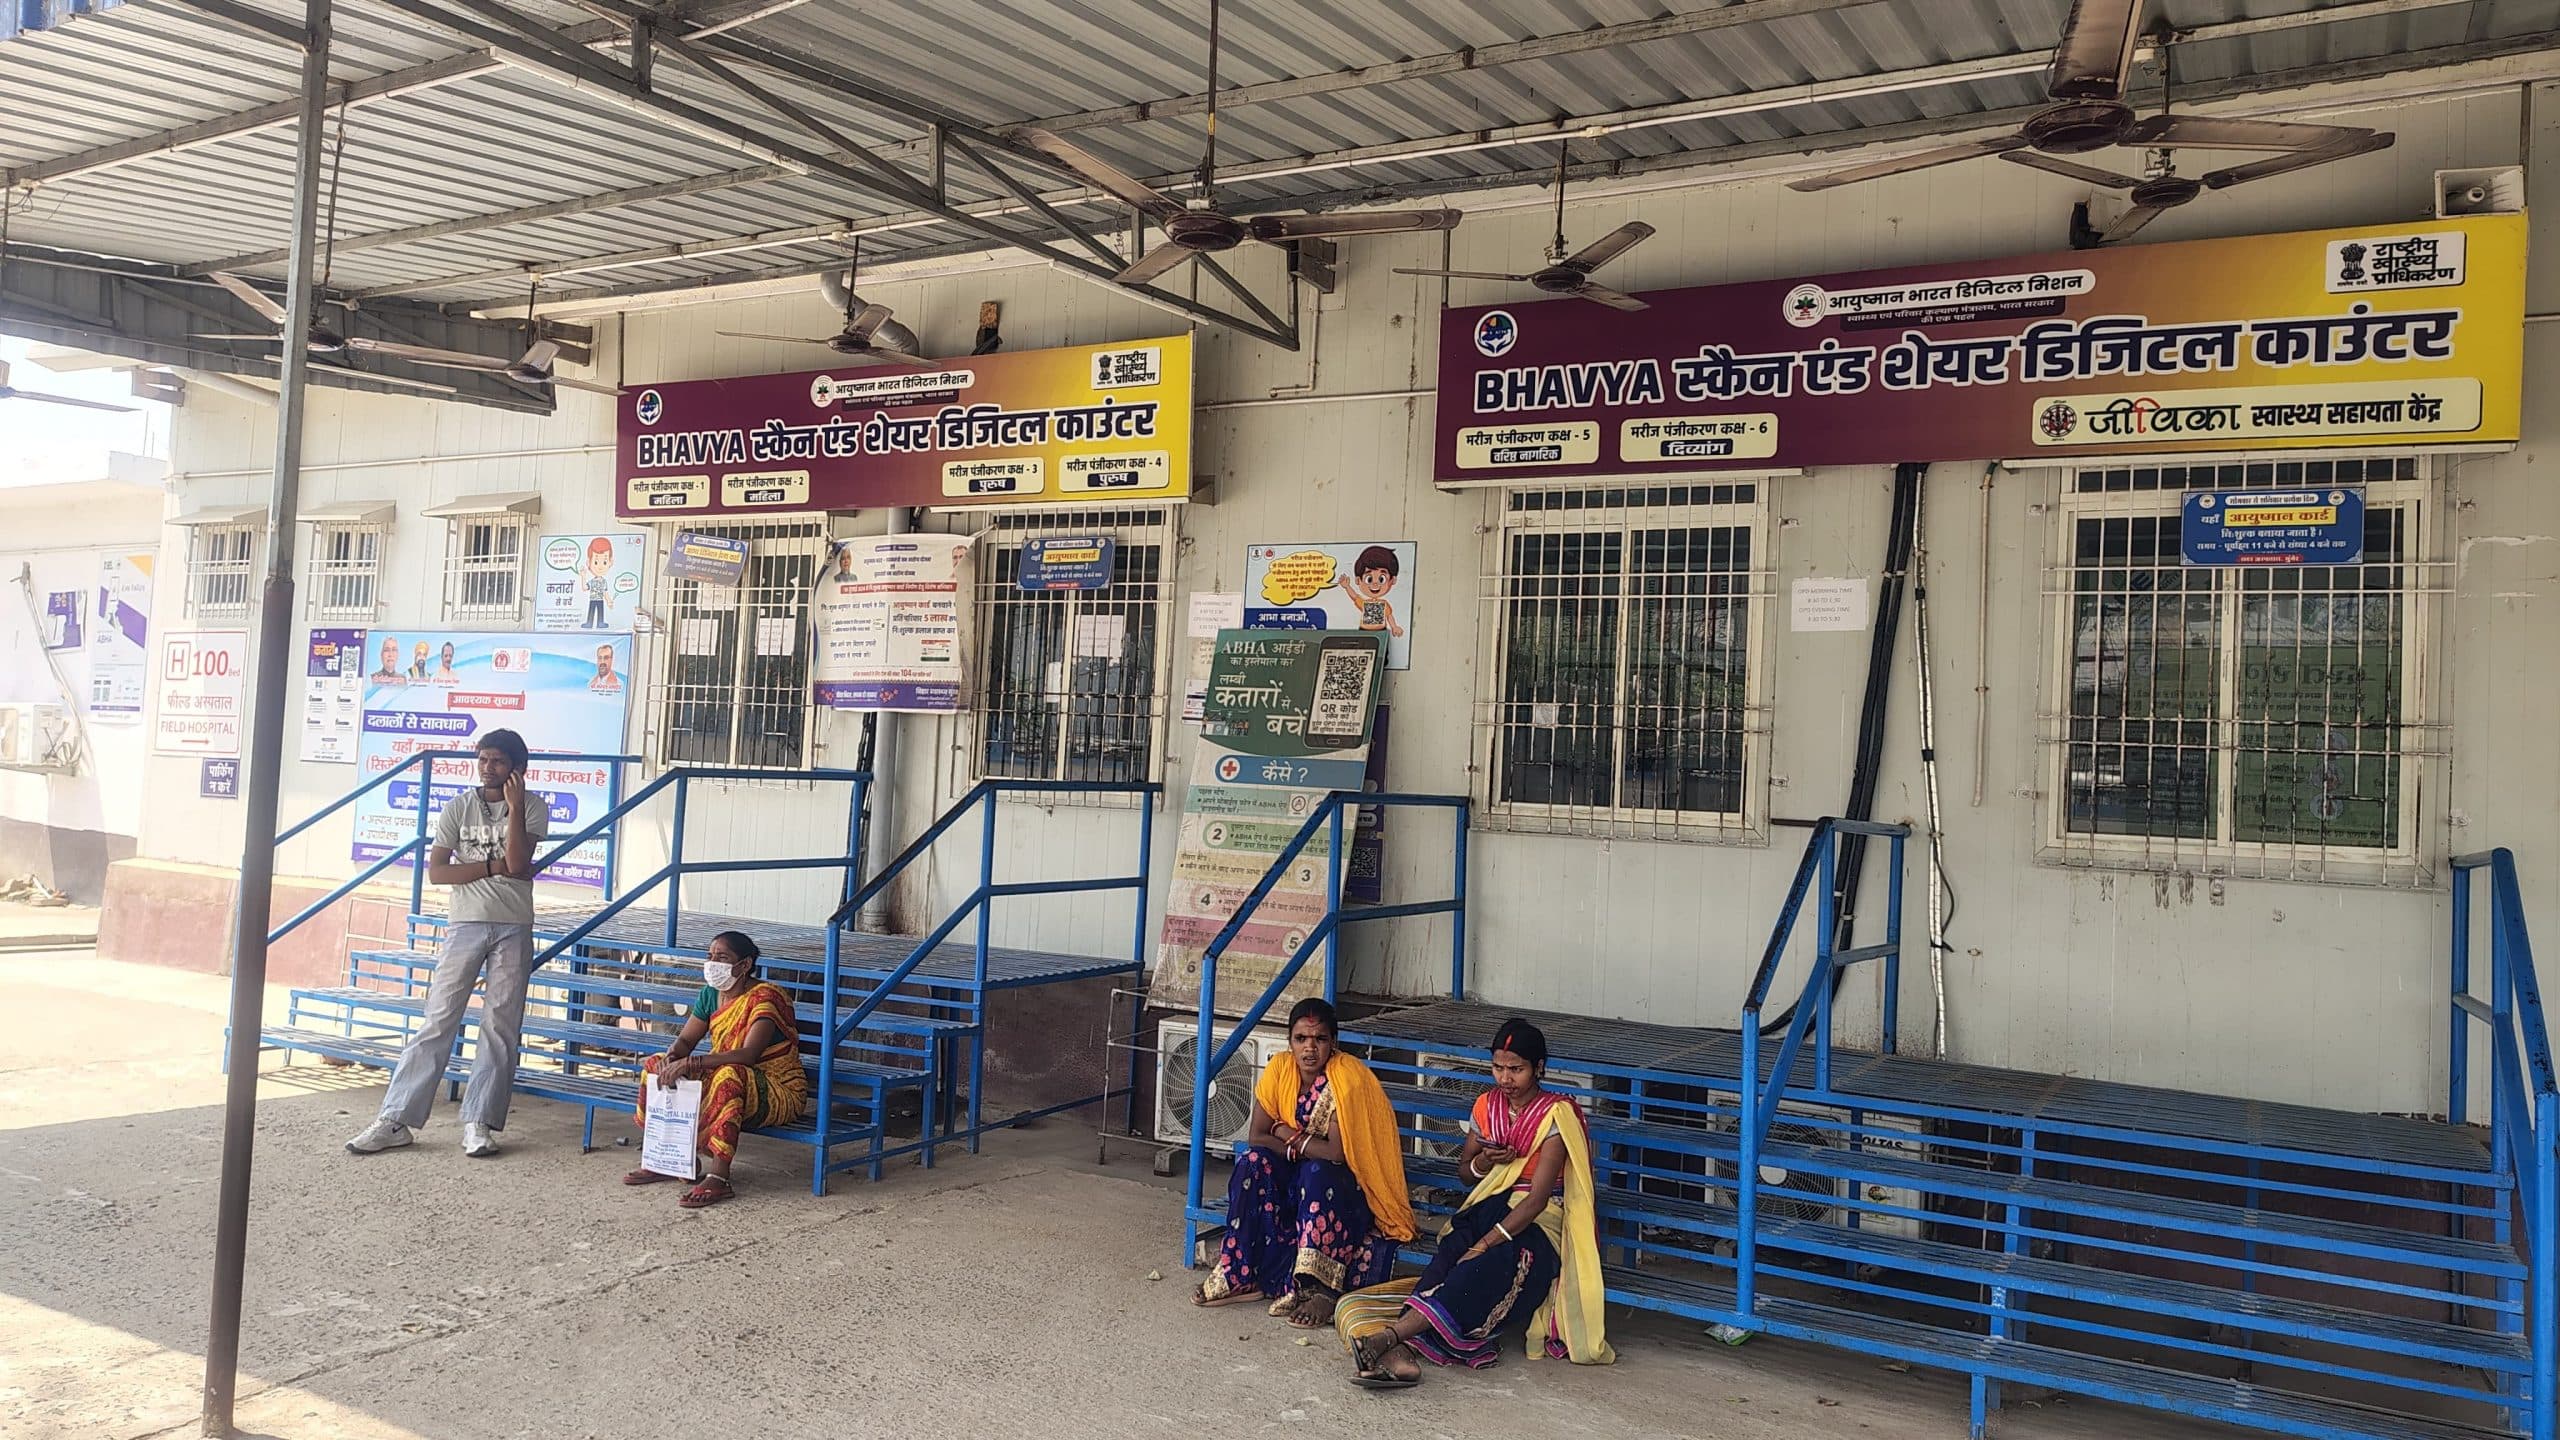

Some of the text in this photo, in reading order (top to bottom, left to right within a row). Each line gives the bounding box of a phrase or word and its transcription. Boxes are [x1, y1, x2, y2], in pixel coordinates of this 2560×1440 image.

[2372, 237, 2439, 256] राष्ट्रीय
[2372, 254, 2438, 270] स्वास्थ्य
[2372, 268, 2456, 285] प्राधिकरण
[1830, 274, 2083, 311] आयुष्मान भारत डिजिटल मिशन
[1894, 309, 1923, 318] परिवार
[2000, 301, 2021, 309] भारत
[2024, 299, 2055, 308] सरकार
[1114, 351, 1147, 363] राष्ट्रीय
[1478, 304, 2458, 411] BHAVYA स्कैन एंड शेयर डिजिटल काउंटर
[836, 373, 969, 396] आयुष्मान भारत डिजिटल मिशन
[2084, 392, 2443, 435] जीविका स्वास्थ्य सहायता केंद्र
[638, 397, 1157, 467] BHAVYA स्कैन एंड शेयर डिजिटल काउंटर
[1631, 423, 1660, 438] मरीज
[1664, 421, 1717, 437] पंजीकरण
[1720, 421, 1746, 435] कक्ष
[1759, 421, 1767, 434] 6
[1466, 431, 1492, 446] मरीज
[1496, 429, 1545, 445] पंजीकरण
[1548, 429, 1571, 443] कक्ष
[1583, 429, 1590, 441] 5
[1494, 446, 1558, 462] वरिष्ठ नागरिक
[1668, 440, 1726, 456] दिव्यांग
[949, 464, 968, 477] मरीज
[970, 463, 1005, 476] पंजीकरण
[1008, 463, 1024, 475] कक्ष
[1032, 464, 1038, 474] 3
[1066, 457, 1087, 472] मरीज
[1089, 456, 1127, 471] पंजीकरण
[1129, 457, 1146, 469] कक्ष
[1155, 457, 1161, 467] 4
[727, 477, 744, 489] मरीज
[746, 475, 776, 488] पंजीकरण
[777, 476, 792, 487] कक्ष
[799, 476, 804, 486] 2
[978, 478, 1006, 492] पुरुष
[1099, 471, 1128, 486] पुरुष
[633, 481, 649, 493] मरीज
[651, 479, 679, 492] पंजीकरण
[681, 481, 694, 491] कक्ष
[700, 481, 705, 490] 1
[653, 493, 684, 505] महिला
[748, 490, 781, 502] महिला
[2201, 508, 2332, 525] यहाँ आयुष्मान कार्ड
[2258, 529, 2308, 538] बनाया जाता
[2263, 539, 2276, 549] बजे
[546, 580, 576, 594] कतारों
[930, 614, 948, 622] लाख
[1258, 613, 1278, 623] आभा
[1221, 641, 1266, 655] ABHA
[1271, 642, 1305, 655] आईडी
[171, 649, 241, 677] H 100 Bed
[1230, 657, 1243, 667] का
[1280, 657, 1295, 668] कर
[901, 669, 912, 677] 104
[1219, 671, 1247, 685] लम्बी
[168, 690, 232, 711] फील्ड अस्पताल
[453, 695, 491, 706] आवश्यक
[1215, 680, 1292, 709] कतारों से
[1320, 701, 1358, 713] QR कोड
[160, 721, 235, 735] FIELD HOSPITAL
[367, 712, 468, 732] दलालों से सावधान
[1266, 707, 1308, 737] बचें
[544, 768, 607, 787] उपलब्ध है
[1262, 759, 1293, 782] कैसे
[1212, 828, 1223, 841] 2
[1302, 869, 1311, 882] 3
[1200, 893, 1211, 906] 4
[1288, 936, 1299, 949] 5
[1186, 961, 1196, 973] 6
[1862, 1136, 1904, 1150] OLTAS
